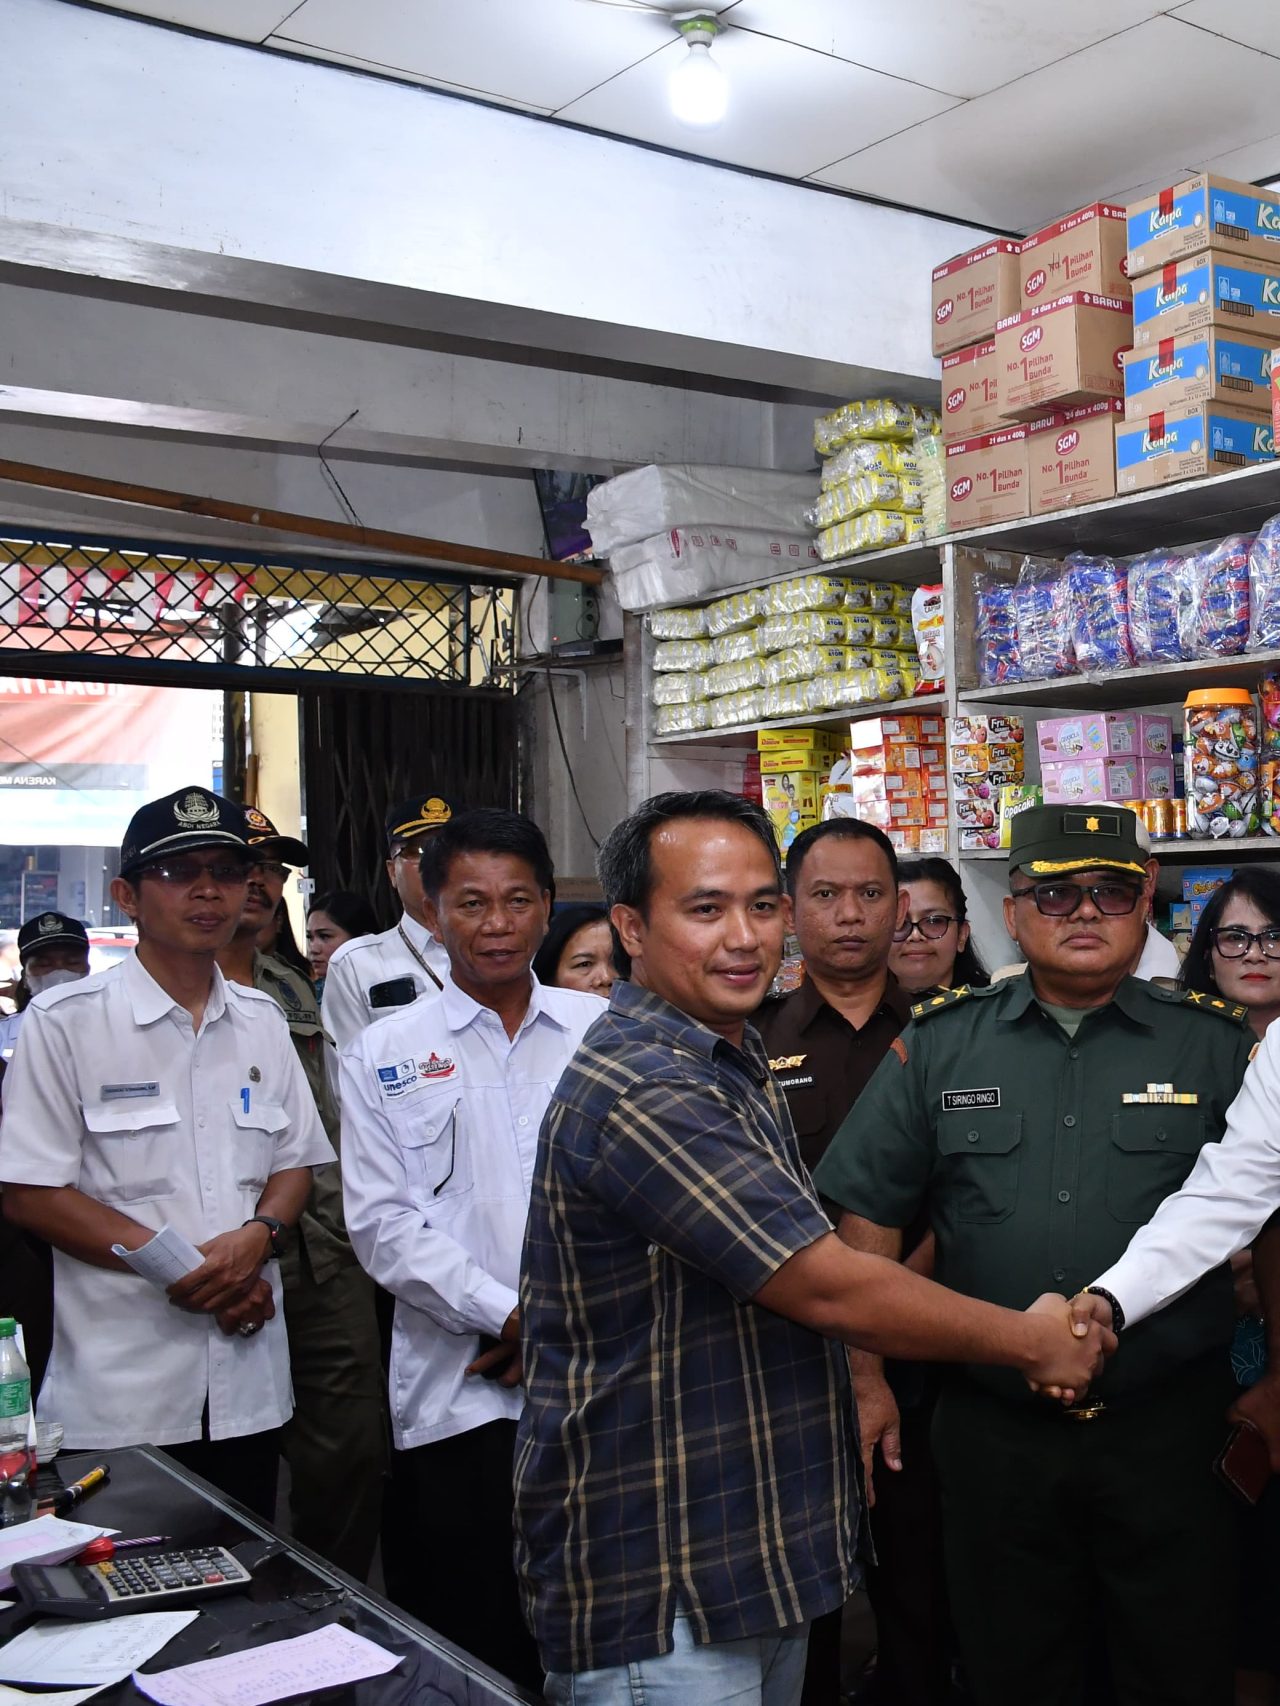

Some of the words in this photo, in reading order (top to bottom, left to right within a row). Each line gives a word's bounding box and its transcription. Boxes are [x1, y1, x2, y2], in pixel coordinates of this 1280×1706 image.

[1049, 261, 1061, 272] No.
[1062, 256, 1070, 280] 1
[1070, 250, 1094, 265] Pilihan
[1070, 263, 1092, 278] Bunda
[1026, 272, 1045, 294] SGM
[956, 291, 967, 302] No.
[968, 288, 974, 310] 1
[974, 283, 995, 297] Pilihan
[974, 296, 993, 309] Bunda
[1092, 295, 1123, 310] BARU!
[936, 301, 952, 322] SGM
[997, 314, 1021, 330] BARU!
[1021, 327, 1041, 349] SGM
[1007, 363, 1019, 373] No.
[1020, 357, 1029, 382] 1
[1028, 353, 1054, 369] Pilihan
[1029, 366, 1052, 380] Bunda
[969, 382, 981, 392] No.
[981, 378, 989, 402] 1
[947, 391, 964, 411] SGM
[1030, 416, 1055, 431] BARU!
[1074, 407, 1086, 418] dus
[1092, 401, 1109, 414] 400g
[1058, 431, 1077, 453] SGM
[976, 472, 989, 482] No.
[990, 469, 997, 492] 1
[998, 469, 1023, 480] Pilihan
[1041, 464, 1054, 474] No.
[1055, 461, 1064, 484] 1
[1064, 458, 1090, 471] Pilihan
[1065, 471, 1088, 484] Bunda
[952, 479, 971, 498] SGM
[998, 480, 1020, 492] Bunda
[178, 821, 194, 829] ABDI
[196, 820, 222, 829] NEGARA
[383, 1075, 418, 1091] unesco
[952, 1094, 976, 1106] SIRINGO
[977, 1092, 996, 1104] RINGO
